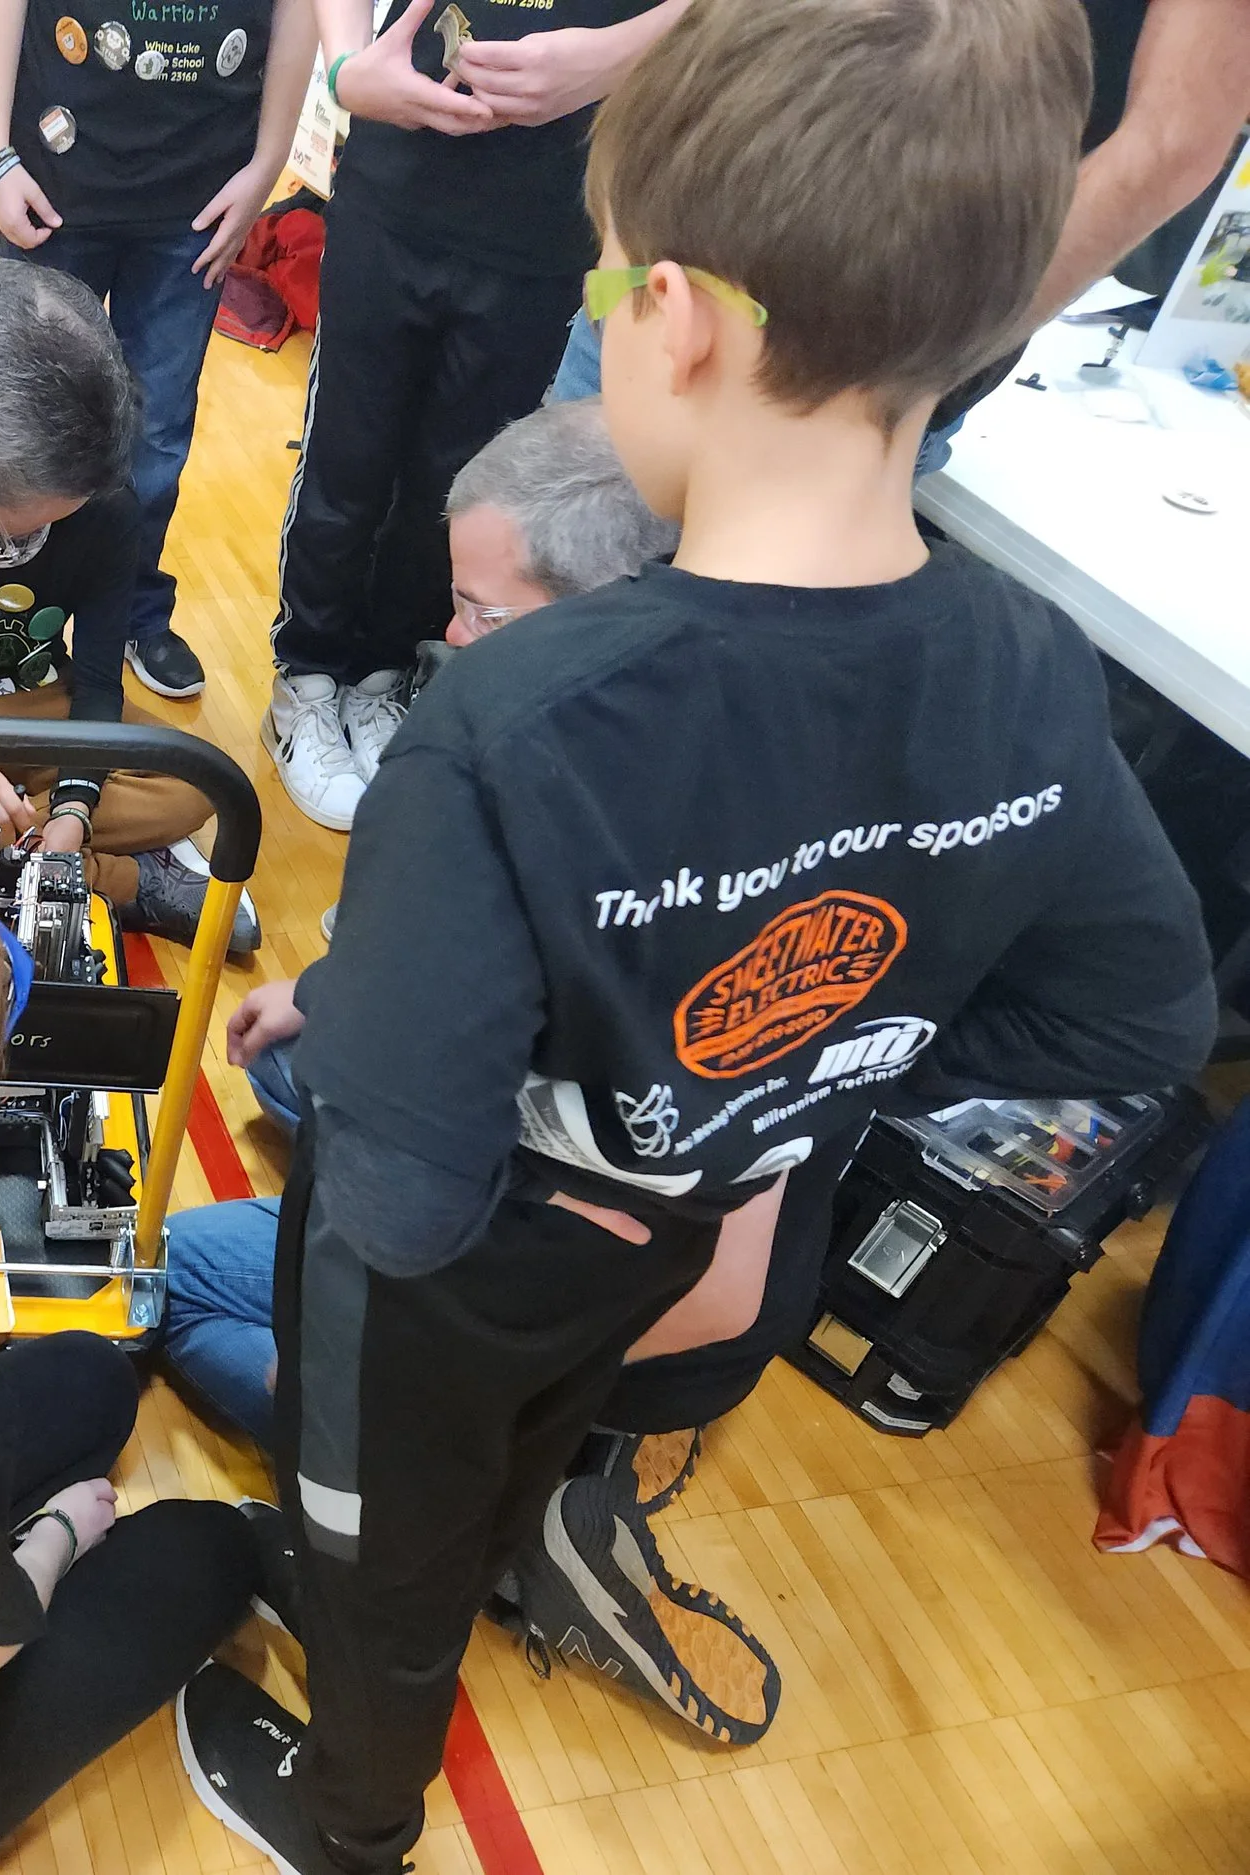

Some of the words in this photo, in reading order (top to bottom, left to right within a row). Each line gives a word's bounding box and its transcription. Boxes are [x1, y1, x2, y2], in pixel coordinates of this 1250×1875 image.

[131, 0, 219, 23] Warriors
[145, 40, 174, 53] White
[176, 42, 200, 54] Lake
[172, 57, 204, 69] School
[170, 72, 198, 82] 23168
[716, 858, 789, 912] you
[791, 840, 826, 875] to
[829, 822, 902, 859] our
